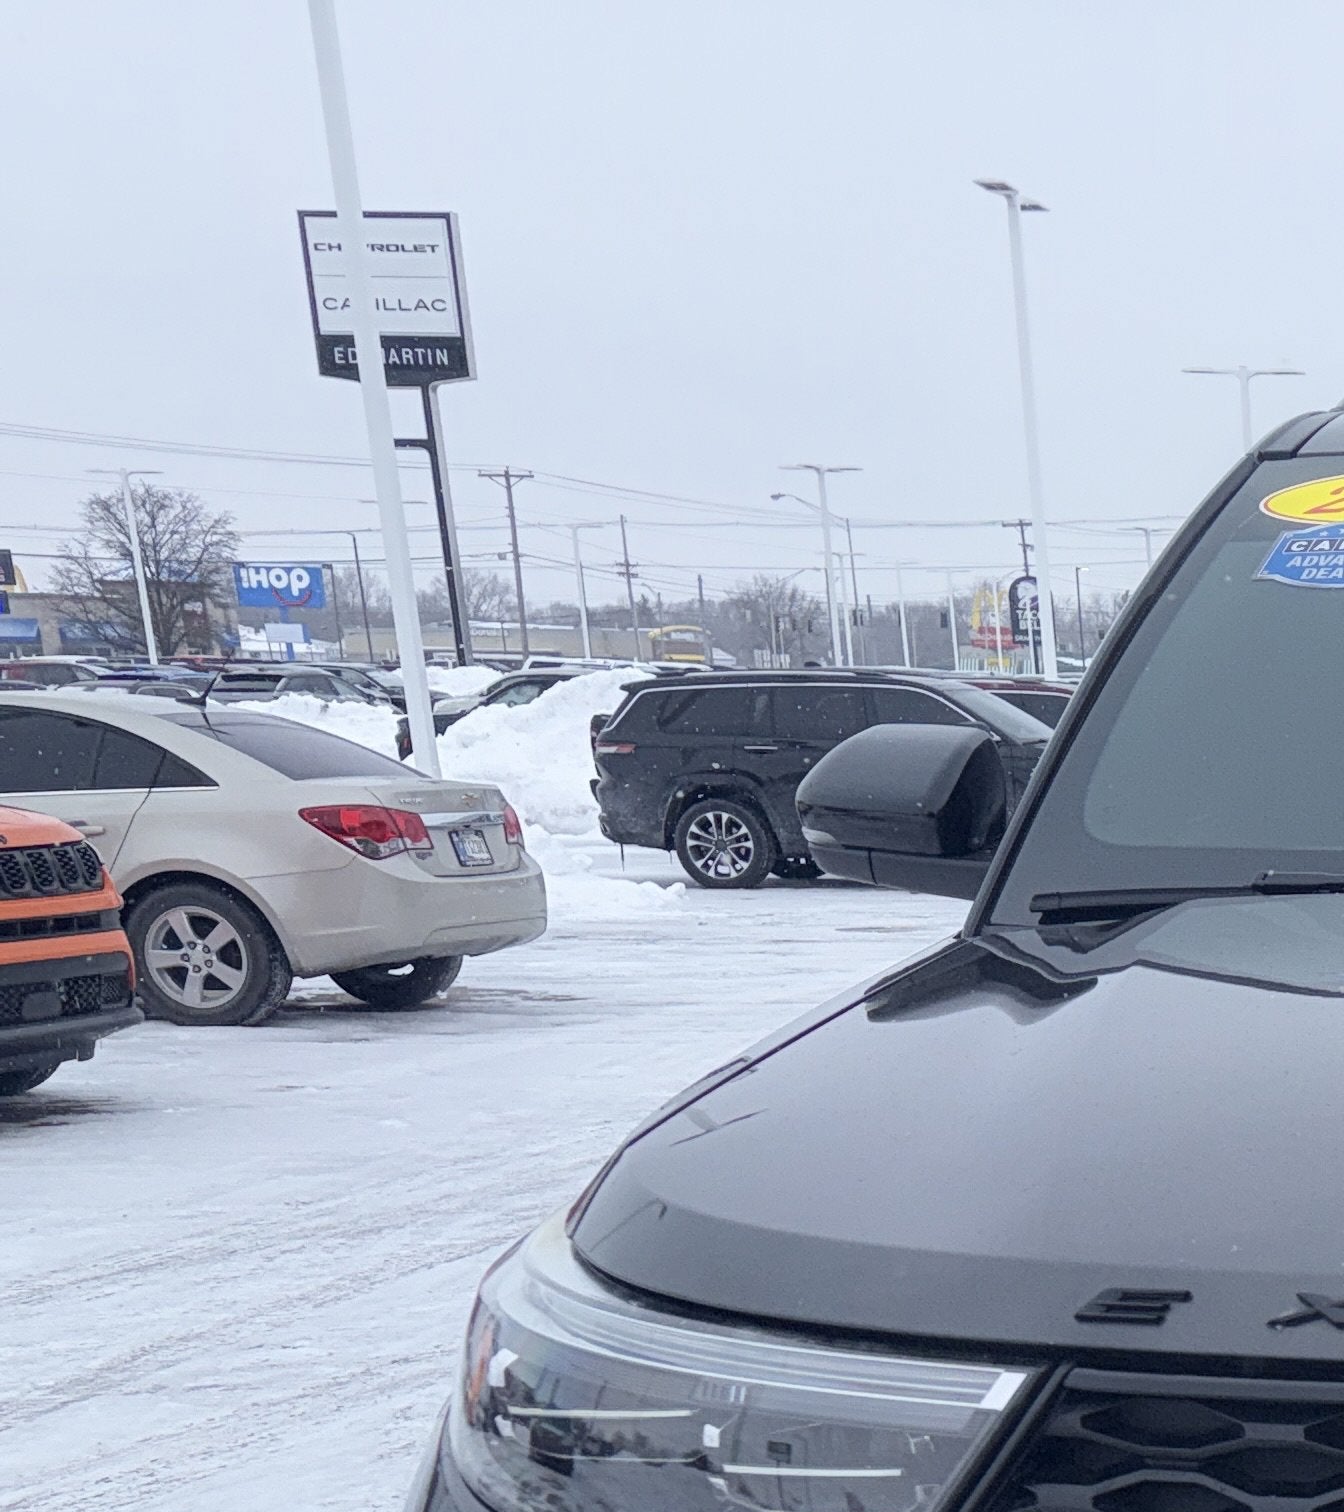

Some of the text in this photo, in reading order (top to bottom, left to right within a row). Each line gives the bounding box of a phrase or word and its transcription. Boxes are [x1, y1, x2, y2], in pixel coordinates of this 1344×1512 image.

[313, 242, 440, 254] CHROLET
[322, 296, 448, 312] CAILLAC
[333, 346, 449, 366] ED ARTIN
